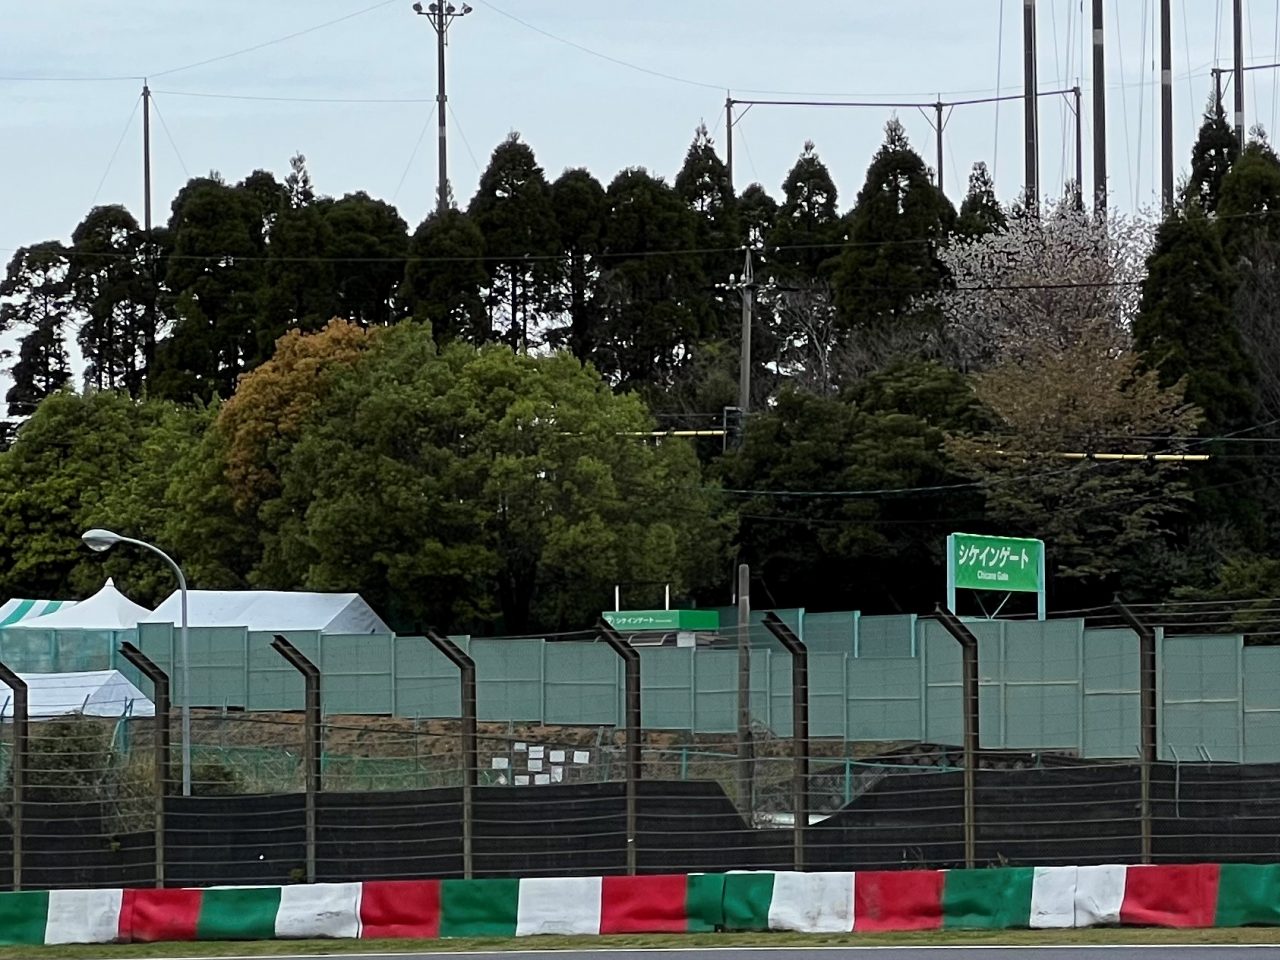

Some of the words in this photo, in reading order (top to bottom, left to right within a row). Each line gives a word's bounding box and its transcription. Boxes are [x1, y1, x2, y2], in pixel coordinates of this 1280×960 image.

[958, 544, 1029, 569] シケインゲート
